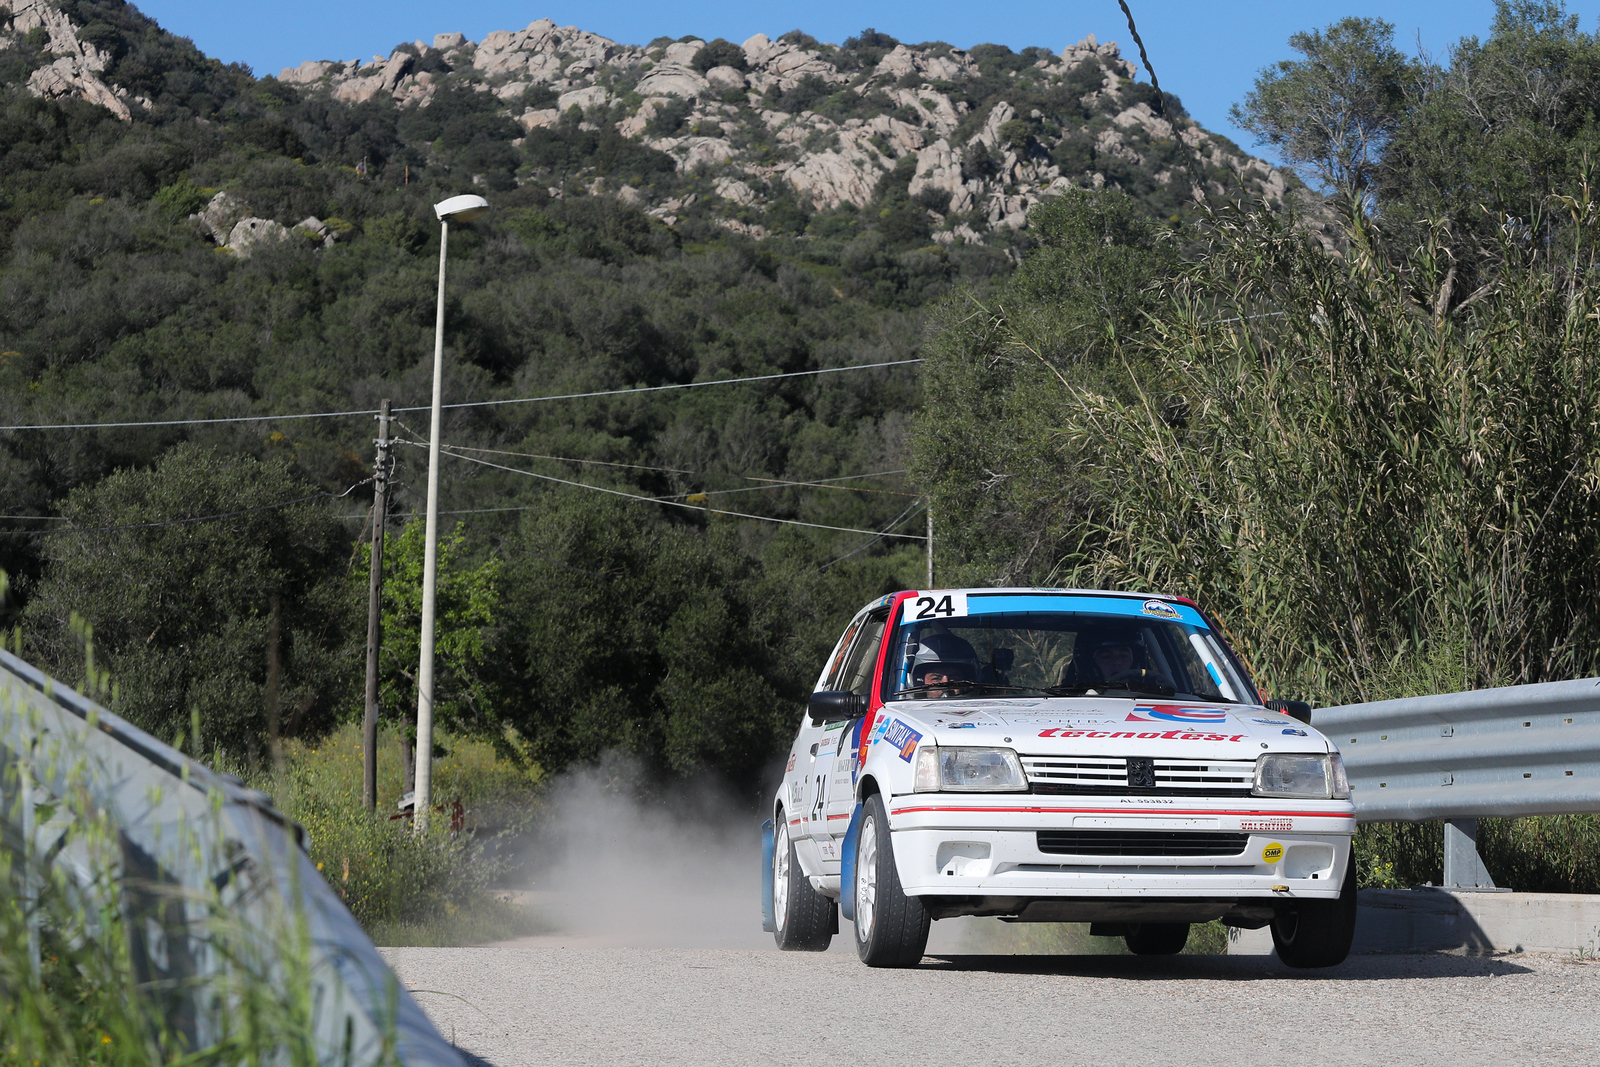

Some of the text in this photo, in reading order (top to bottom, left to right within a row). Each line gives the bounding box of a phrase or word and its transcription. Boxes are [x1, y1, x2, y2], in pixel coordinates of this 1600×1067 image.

[916, 595, 955, 620] 24
[1037, 727, 1249, 743] tecnotest
[811, 773, 828, 821] 24
[1240, 822, 1293, 830] VALENTINO
[1264, 849, 1281, 857] OMP
